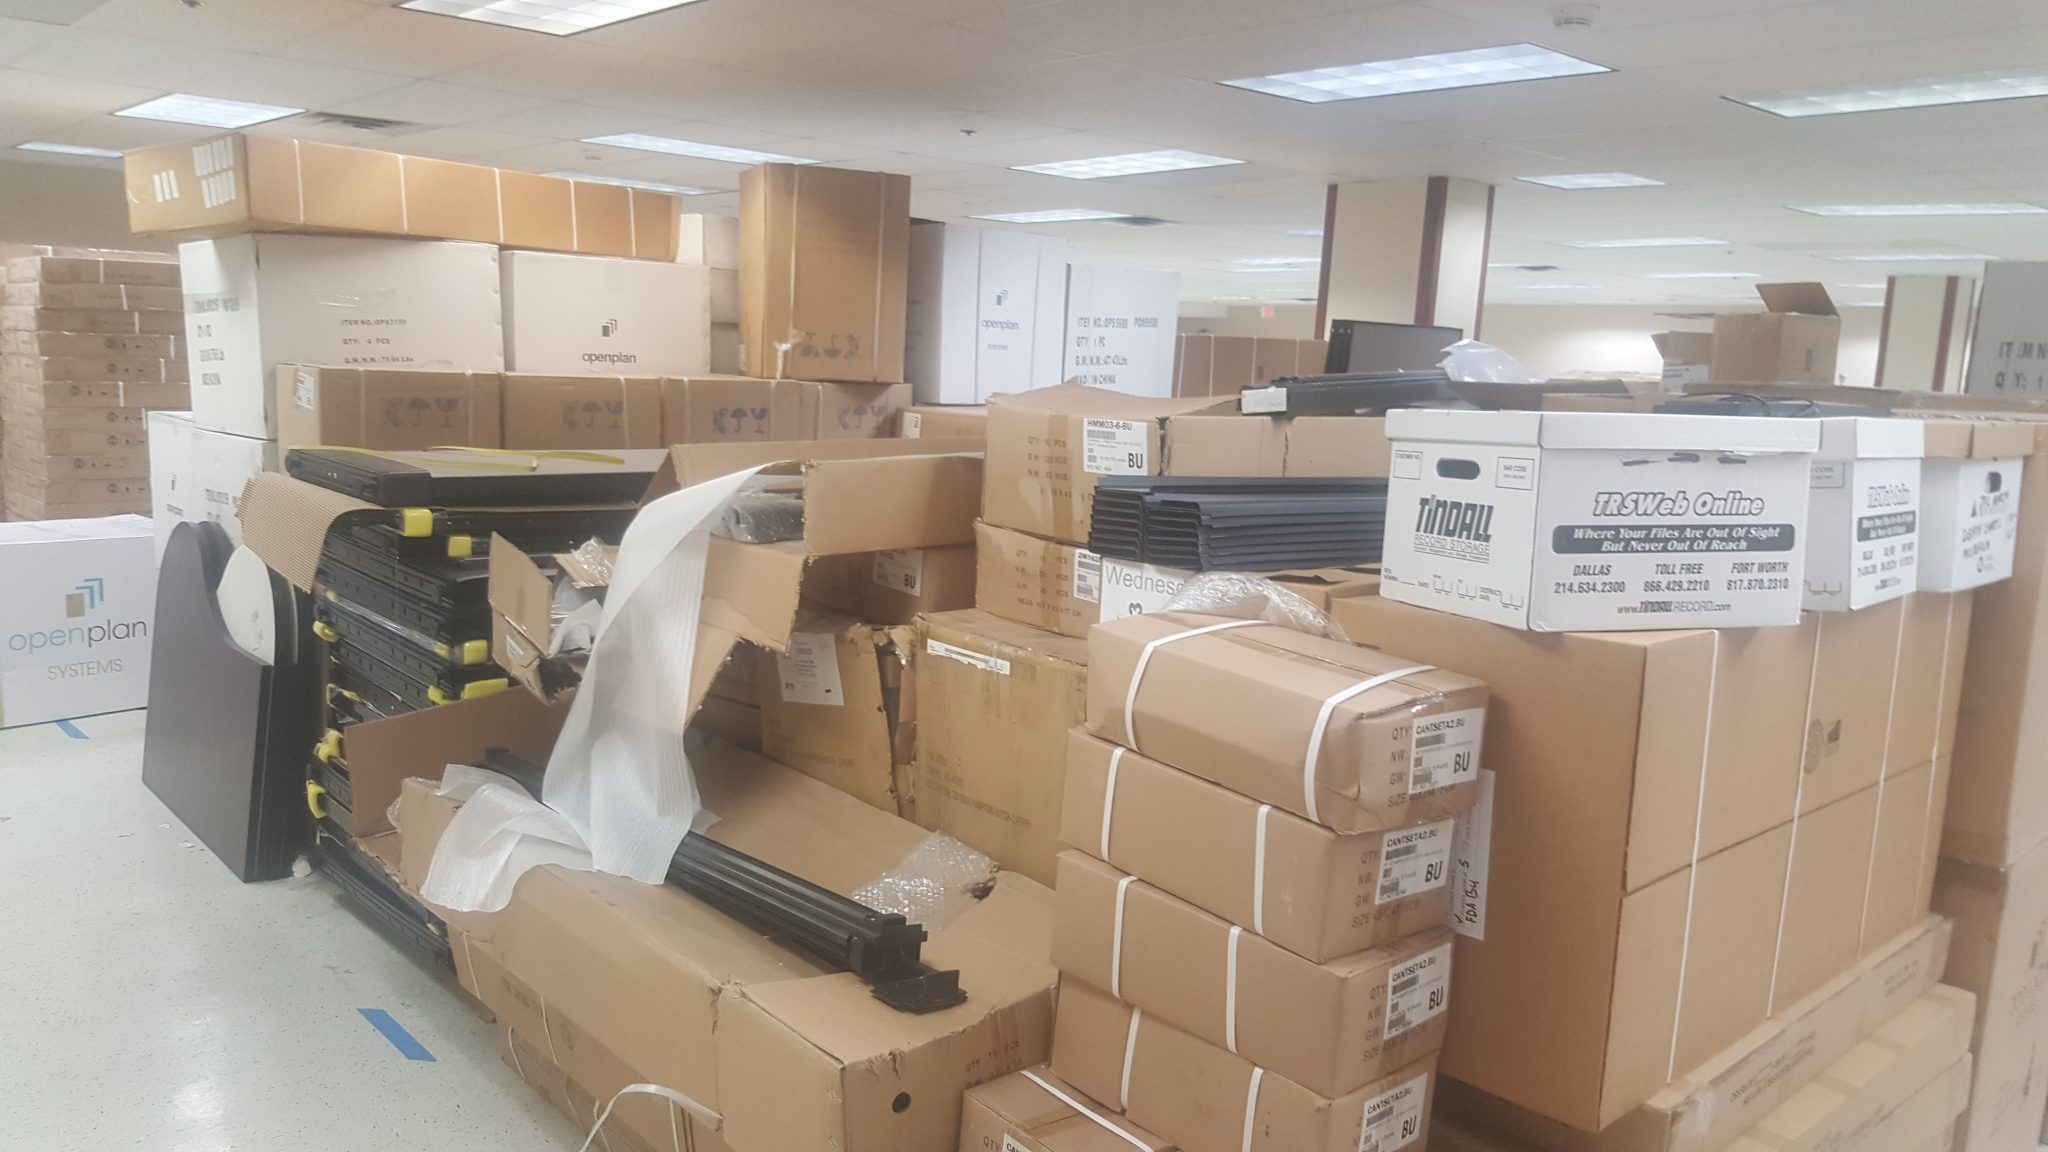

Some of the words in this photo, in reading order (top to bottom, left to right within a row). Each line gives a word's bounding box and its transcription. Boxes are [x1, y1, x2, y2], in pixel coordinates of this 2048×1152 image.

[982, 318, 1020, 331] openplan
[582, 351, 637, 366] openplan
[1127, 452, 1144, 469] BU
[1593, 490, 1690, 516] TRSWeb
[1693, 490, 1765, 516] Online
[1573, 528, 1616, 540] Where
[1619, 528, 1649, 540] Your
[1650, 528, 1680, 539] Files
[1682, 527, 1704, 539] Are
[1706, 527, 1730, 538] Out
[1732, 527, 1748, 538] Of
[1748, 526, 1780, 541] Sight
[1415, 533, 1448, 547] RECORD
[1450, 538, 1491, 555] STORAGE
[1601, 541, 1626, 552] But
[1628, 540, 1665, 552] Never
[1667, 540, 1691, 551] Out
[1693, 540, 1710, 551] Of
[1710, 539, 1748, 551] Reach
[1573, 564, 1612, 576] DALLAS
[1655, 563, 1677, 575] TOLL
[1680, 563, 1704, 575] FREE
[1731, 562, 1756, 574] FORT
[1757, 561, 1789, 573] WORTH
[903, 573, 917, 590] BU
[1554, 581, 1626, 594] 214.634.2300
[1643, 580, 1711, 592] 866.429.2210
[8, 618, 148, 655] openplan
[48, 658, 124, 680] SYSTEMS
[1454, 751, 1471, 774] BU
[1425, 860, 1443, 883] BU
[1428, 986, 1444, 1011] BU
[1401, 1114, 1417, 1140] BU
